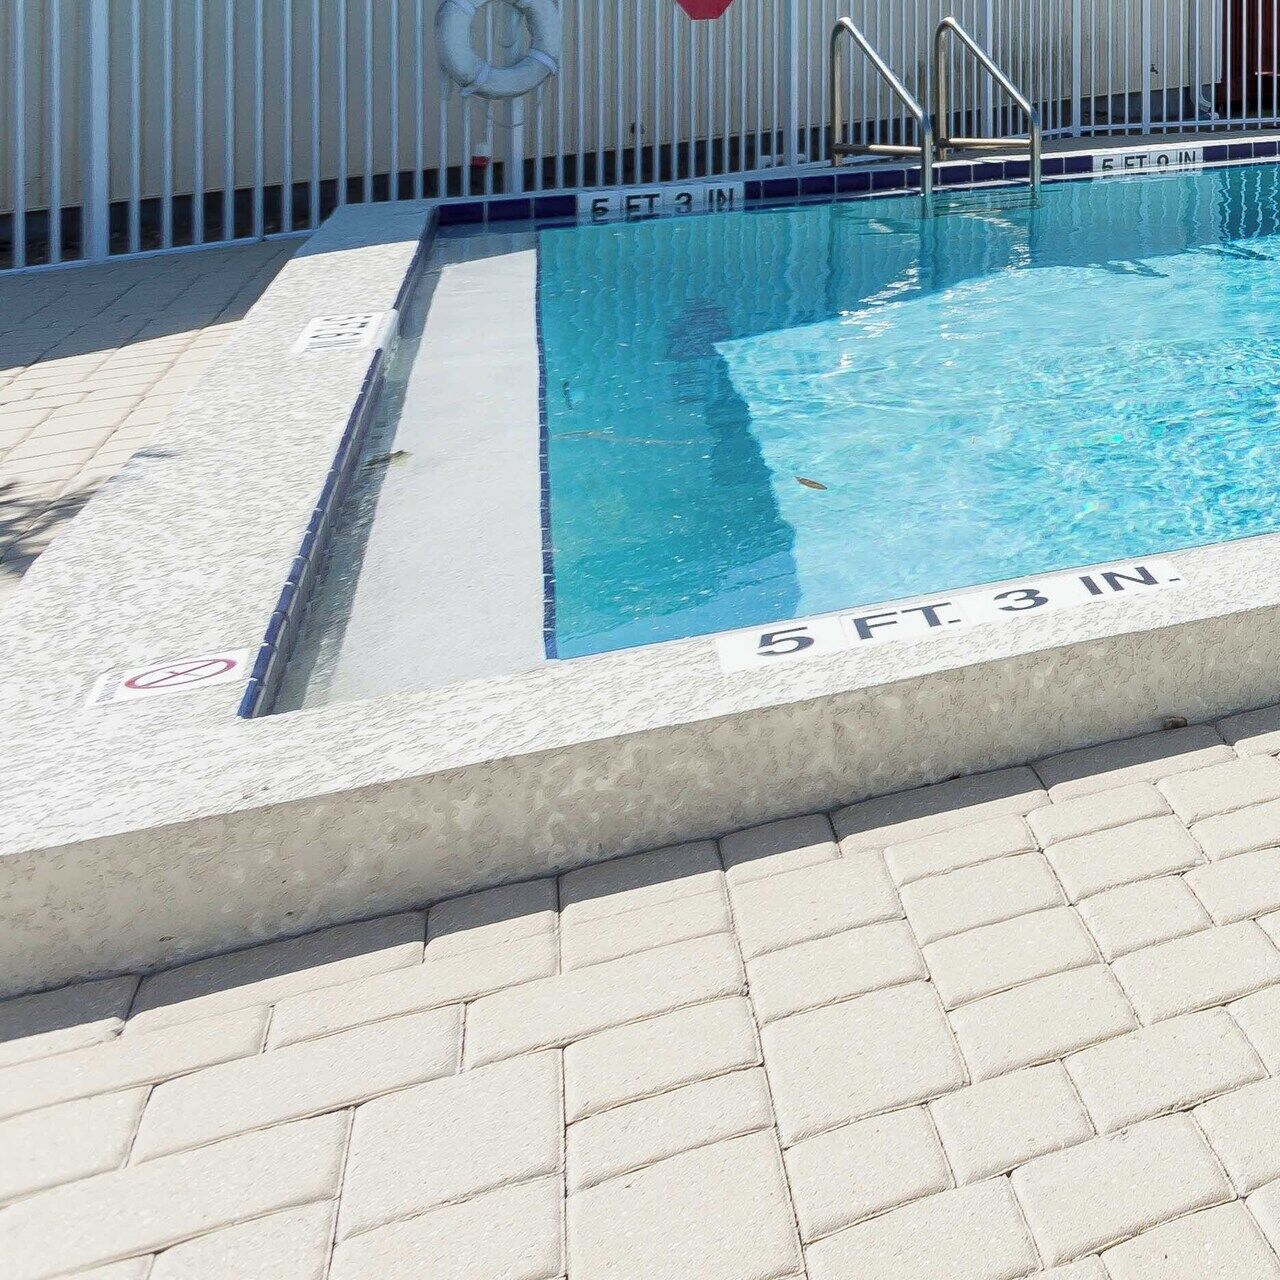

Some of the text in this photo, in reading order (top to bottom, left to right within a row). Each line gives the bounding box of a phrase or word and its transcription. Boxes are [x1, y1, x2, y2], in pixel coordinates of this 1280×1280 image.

[1102, 158, 1113, 171] 5
[1124, 155, 1147, 169] FT
[1178, 151, 1196, 164] IN
[591, 187, 735, 217] 5 FT 3 IN
[756, 566, 1181, 657] 5 FT. 3 IN.
